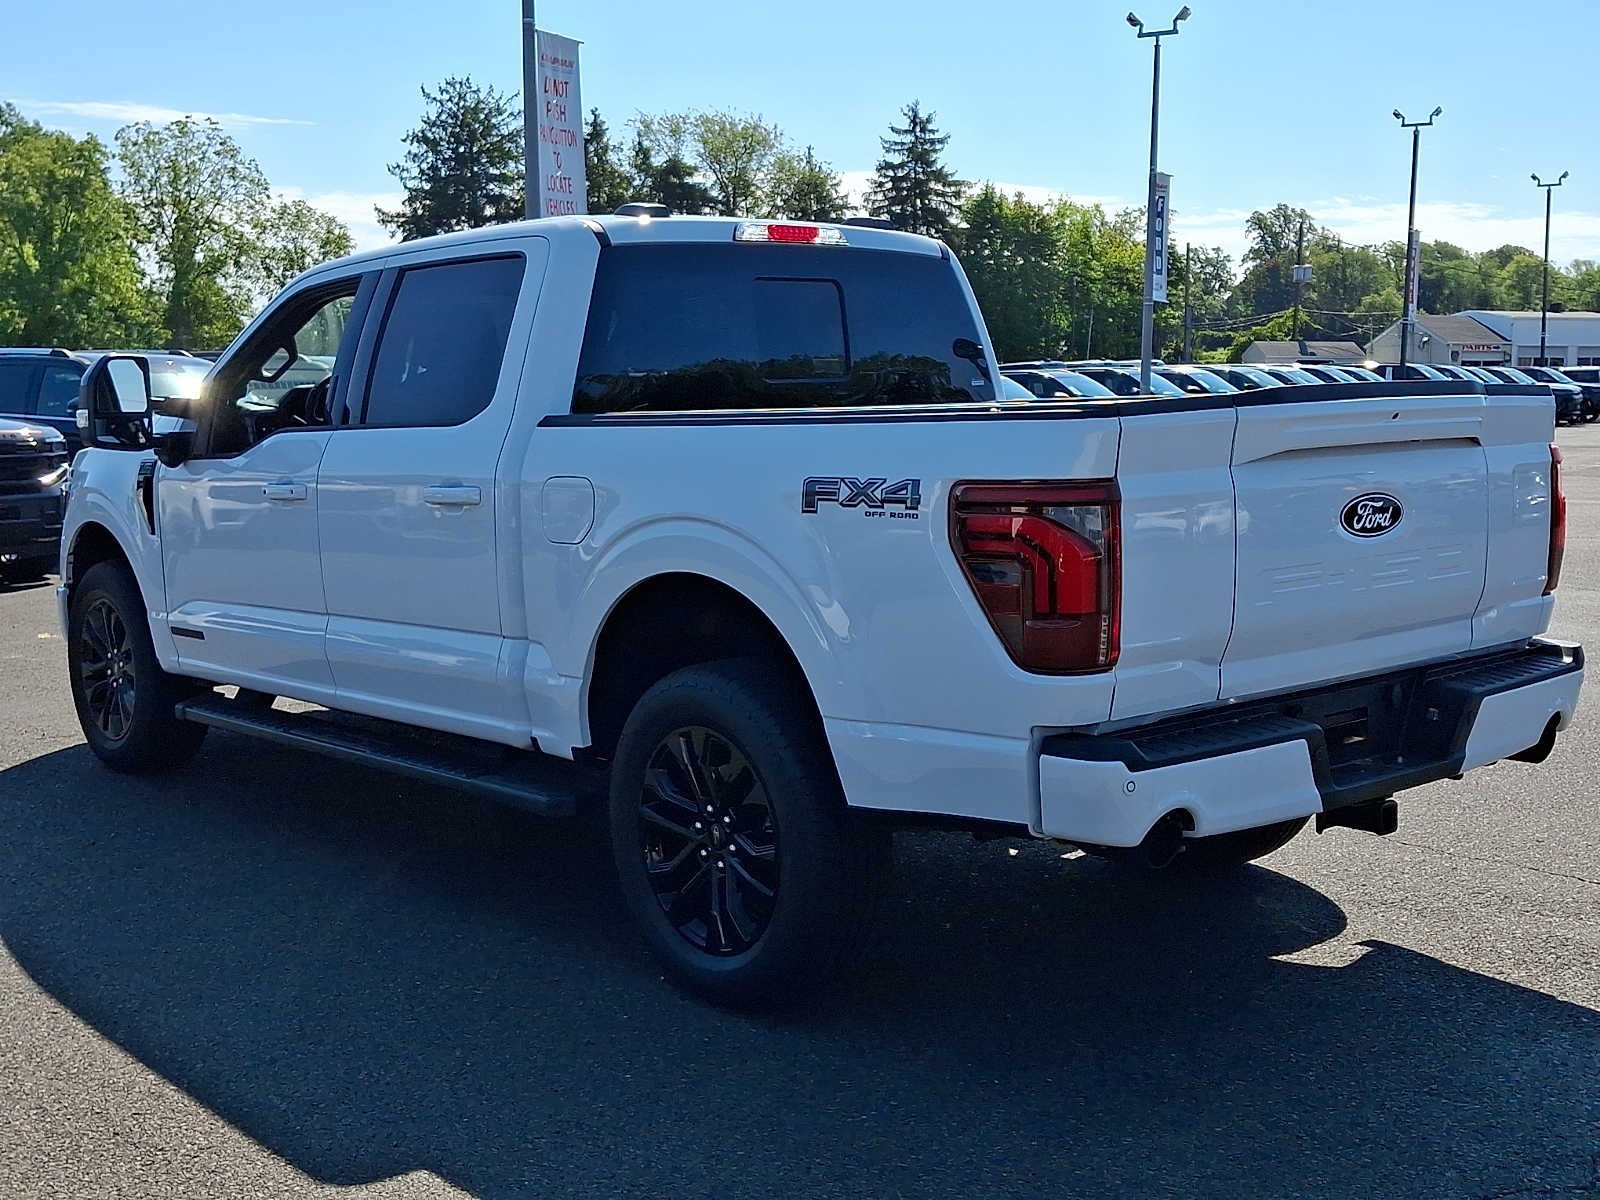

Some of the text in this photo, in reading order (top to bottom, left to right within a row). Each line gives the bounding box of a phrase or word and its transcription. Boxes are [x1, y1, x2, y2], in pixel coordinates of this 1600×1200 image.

[546, 101, 566, 122] PSH
[546, 174, 572, 194] LOCATE
[801, 476, 922, 513] FX4
[864, 510, 919, 520] OFF ROAD
[1354, 500, 1394, 530] Ford
